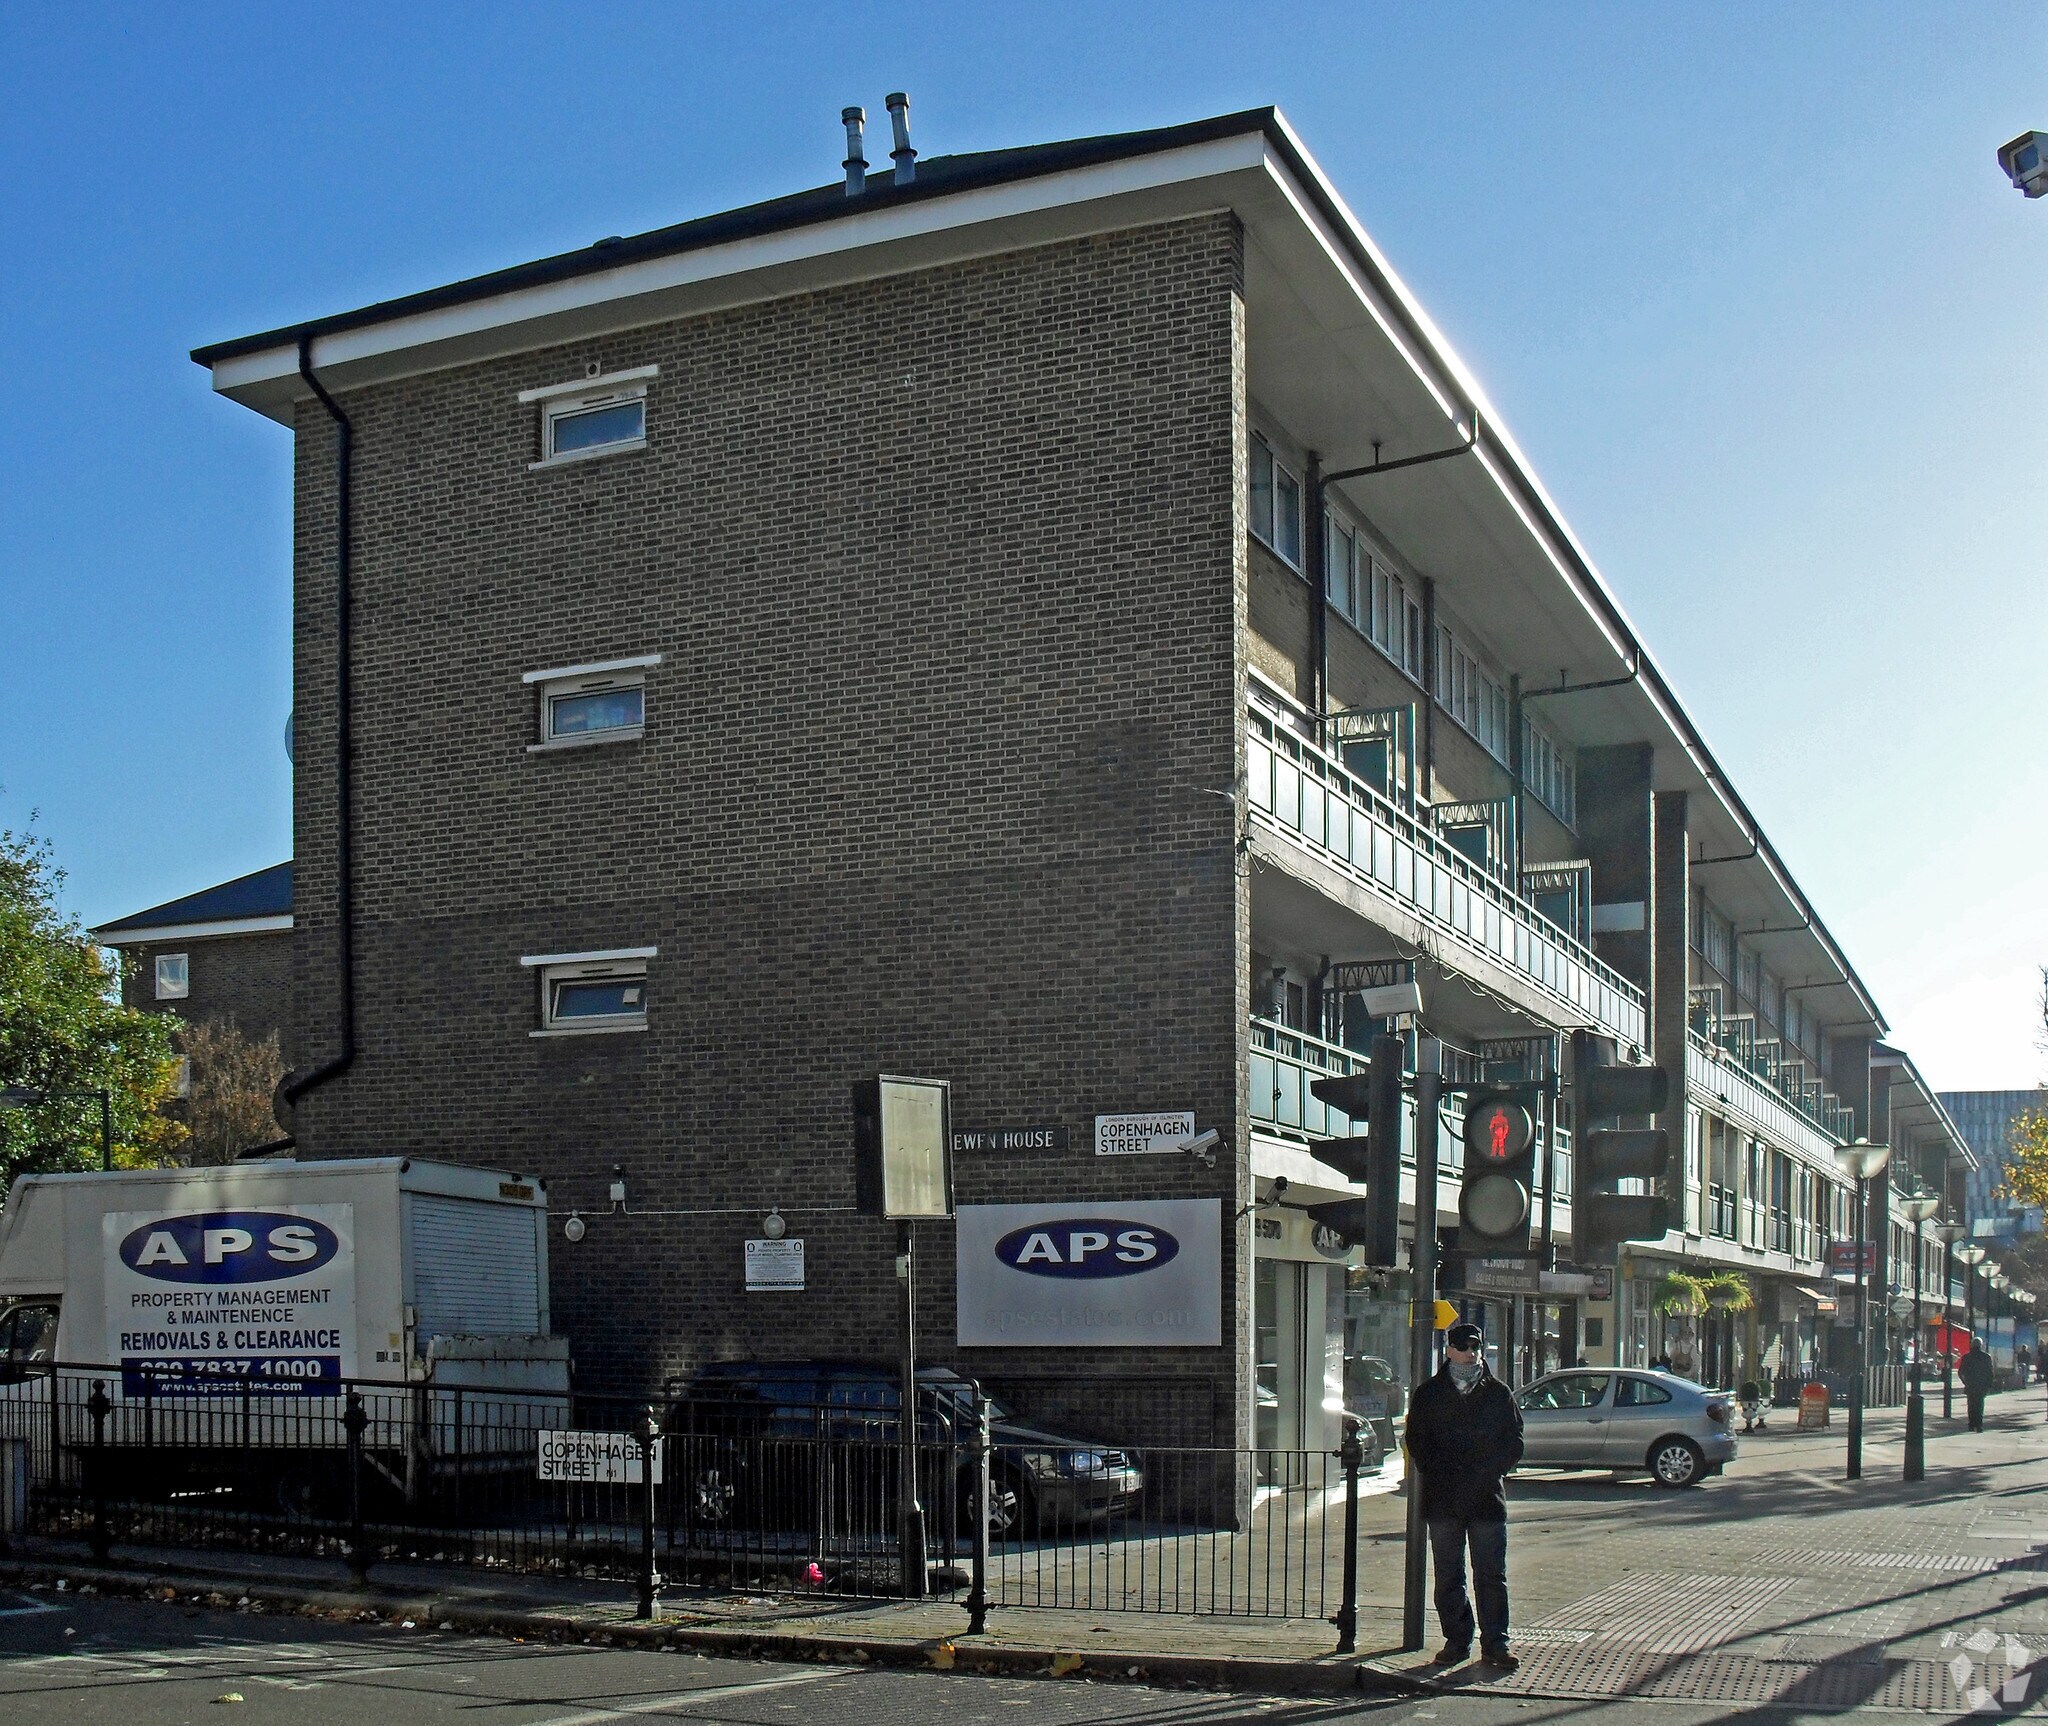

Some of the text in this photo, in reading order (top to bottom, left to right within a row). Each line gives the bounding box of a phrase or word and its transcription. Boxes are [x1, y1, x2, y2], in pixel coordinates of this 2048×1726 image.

[1101, 1122, 1190, 1137] COPENHAGEN
[1004, 1130, 1054, 1149] HOUSE
[1101, 1138, 1151, 1152] STREET
[136, 1225, 318, 1266] APS
[1317, 1225, 1343, 1248] AP
[1016, 1230, 1157, 1263] APS
[131, 1289, 331, 1307] PROPERTY MANAGEMENT
[167, 1309, 294, 1324] & MAINTENENCE
[985, 1306, 1194, 1332] apsestates.com
[121, 1330, 340, 1350] REMOVALS & CLEARANCE
[140, 1360, 322, 1380] 020 7837 1000
[159, 1381, 302, 1394] www.apsesttes.com
